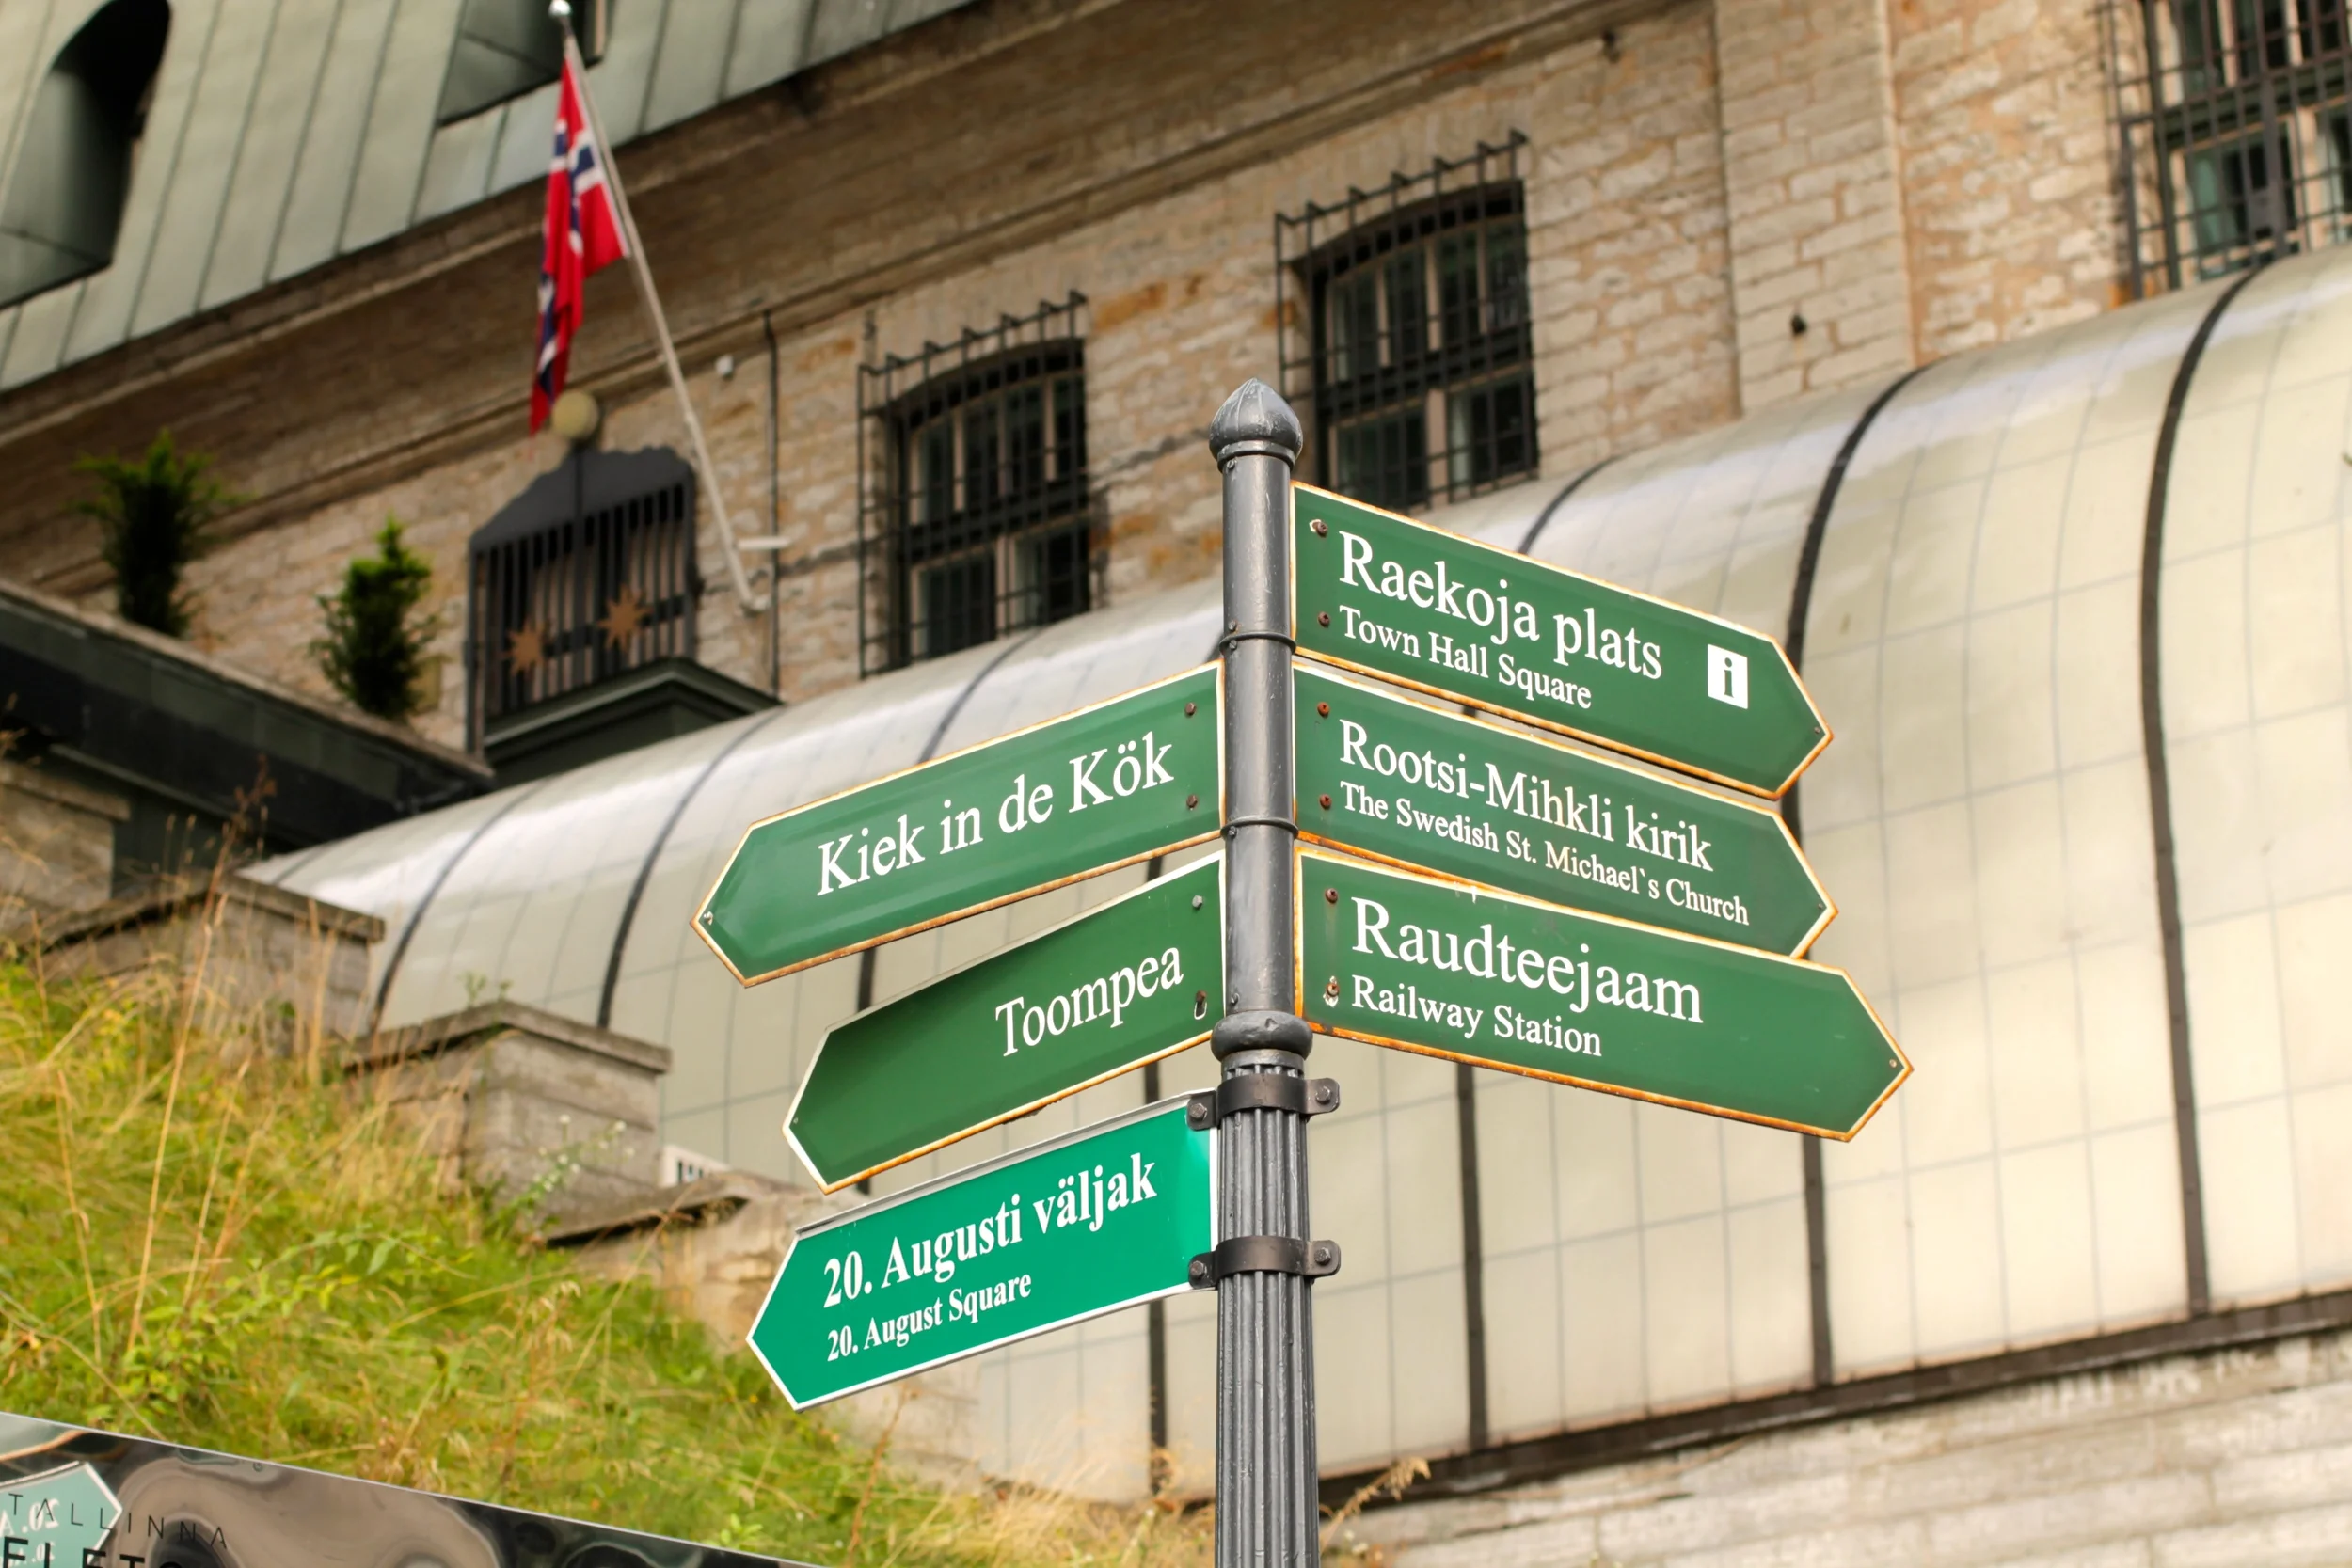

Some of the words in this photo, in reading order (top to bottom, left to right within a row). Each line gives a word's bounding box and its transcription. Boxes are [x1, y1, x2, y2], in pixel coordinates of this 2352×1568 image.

[1338, 530, 1541, 646] Raekoja
[1552, 607, 1662, 680] plats
[1339, 604, 1422, 658] Town
[1427, 631, 1489, 679] Hall
[1498, 653, 1592, 709] Square
[816, 813, 926, 896] Kiek
[939, 799, 984, 855] in
[997, 773, 1054, 834] de
[1068, 730, 1175, 814] Kök
[1339, 718, 1615, 843] Rootsi-Mihkli
[1624, 804, 1714, 872] kirik
[1339, 780, 1389, 820] The
[1395, 797, 1500, 853] Swedish
[1505, 829, 1537, 864] St.
[1665, 878, 1750, 927] Church
[994, 947, 1184, 1057] Toompea
[1350, 896, 1704, 1024] Raudteejaam
[1351, 974, 1484, 1039] Railway
[1493, 1004, 1602, 1057] Station
[823, 1251, 873, 1308] 20.
[881, 1193, 1023, 1289] Augusti
[1033, 1152, 1157, 1234] väljak
[827, 1325, 859, 1362] 20.
[864, 1297, 943, 1350] August
[949, 1274, 1032, 1323] Square
[8, 1492, 228, 1550] TALLINNA
